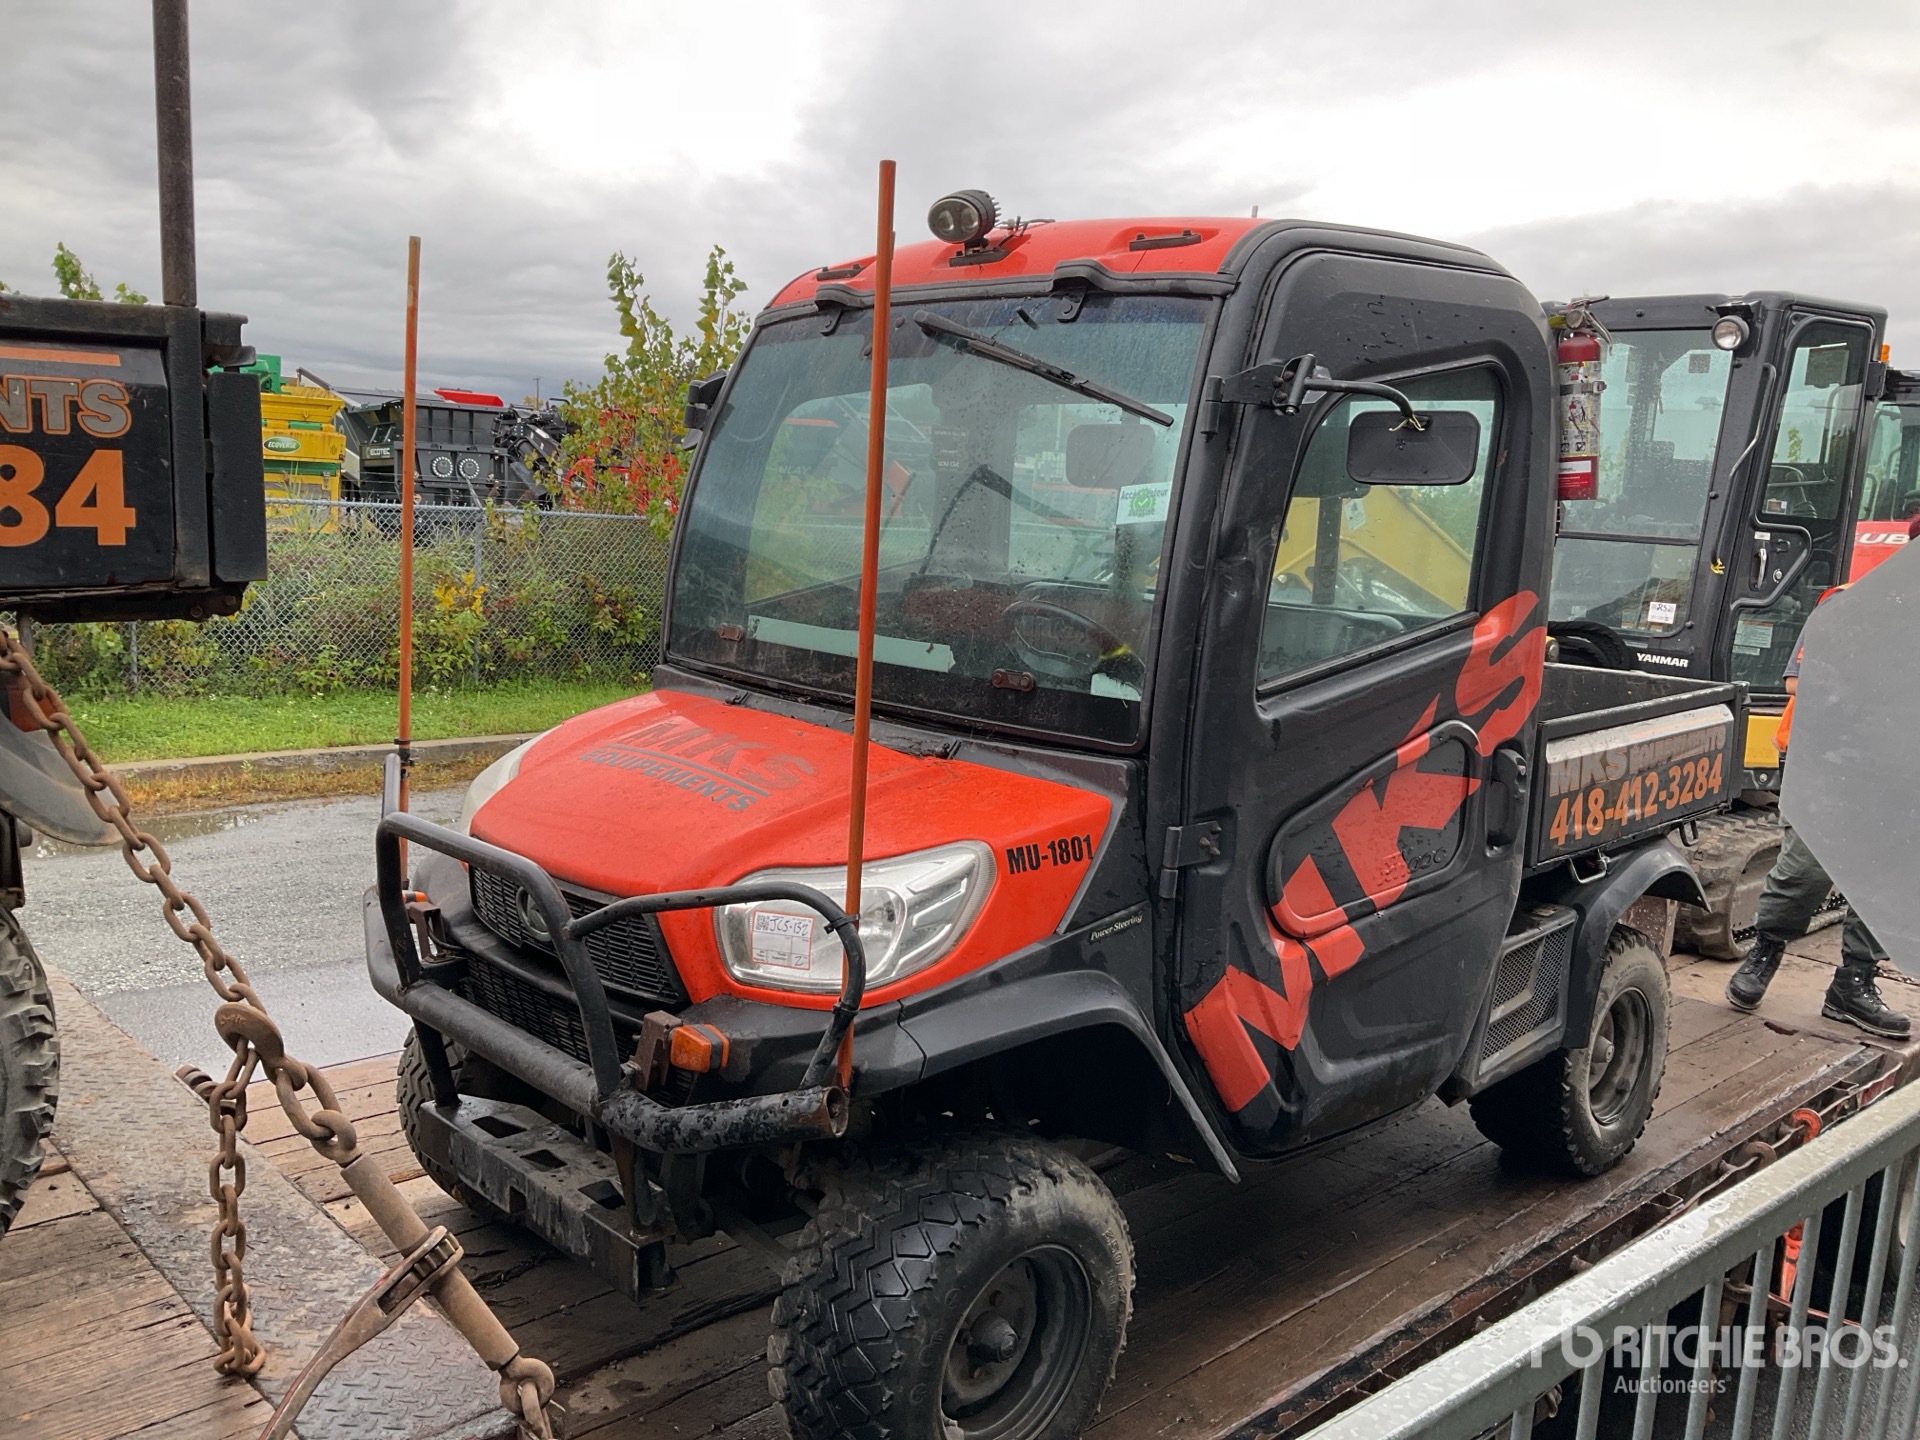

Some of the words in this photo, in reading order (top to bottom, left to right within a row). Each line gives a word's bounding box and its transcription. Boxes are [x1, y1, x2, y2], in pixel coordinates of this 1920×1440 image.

[267, 440, 298, 449] ECOVERSE
[1636, 652, 1689, 668] YANMAR
[577, 749, 759, 812] EQUIPEMENTS
[1549, 752, 1724, 847] 418-412-3284
[1006, 834, 1094, 875] MU-1801
[1184, 589, 1548, 1112] MKS
[1090, 926, 1114, 941] Power
[1113, 914, 1144, 932] Steering
